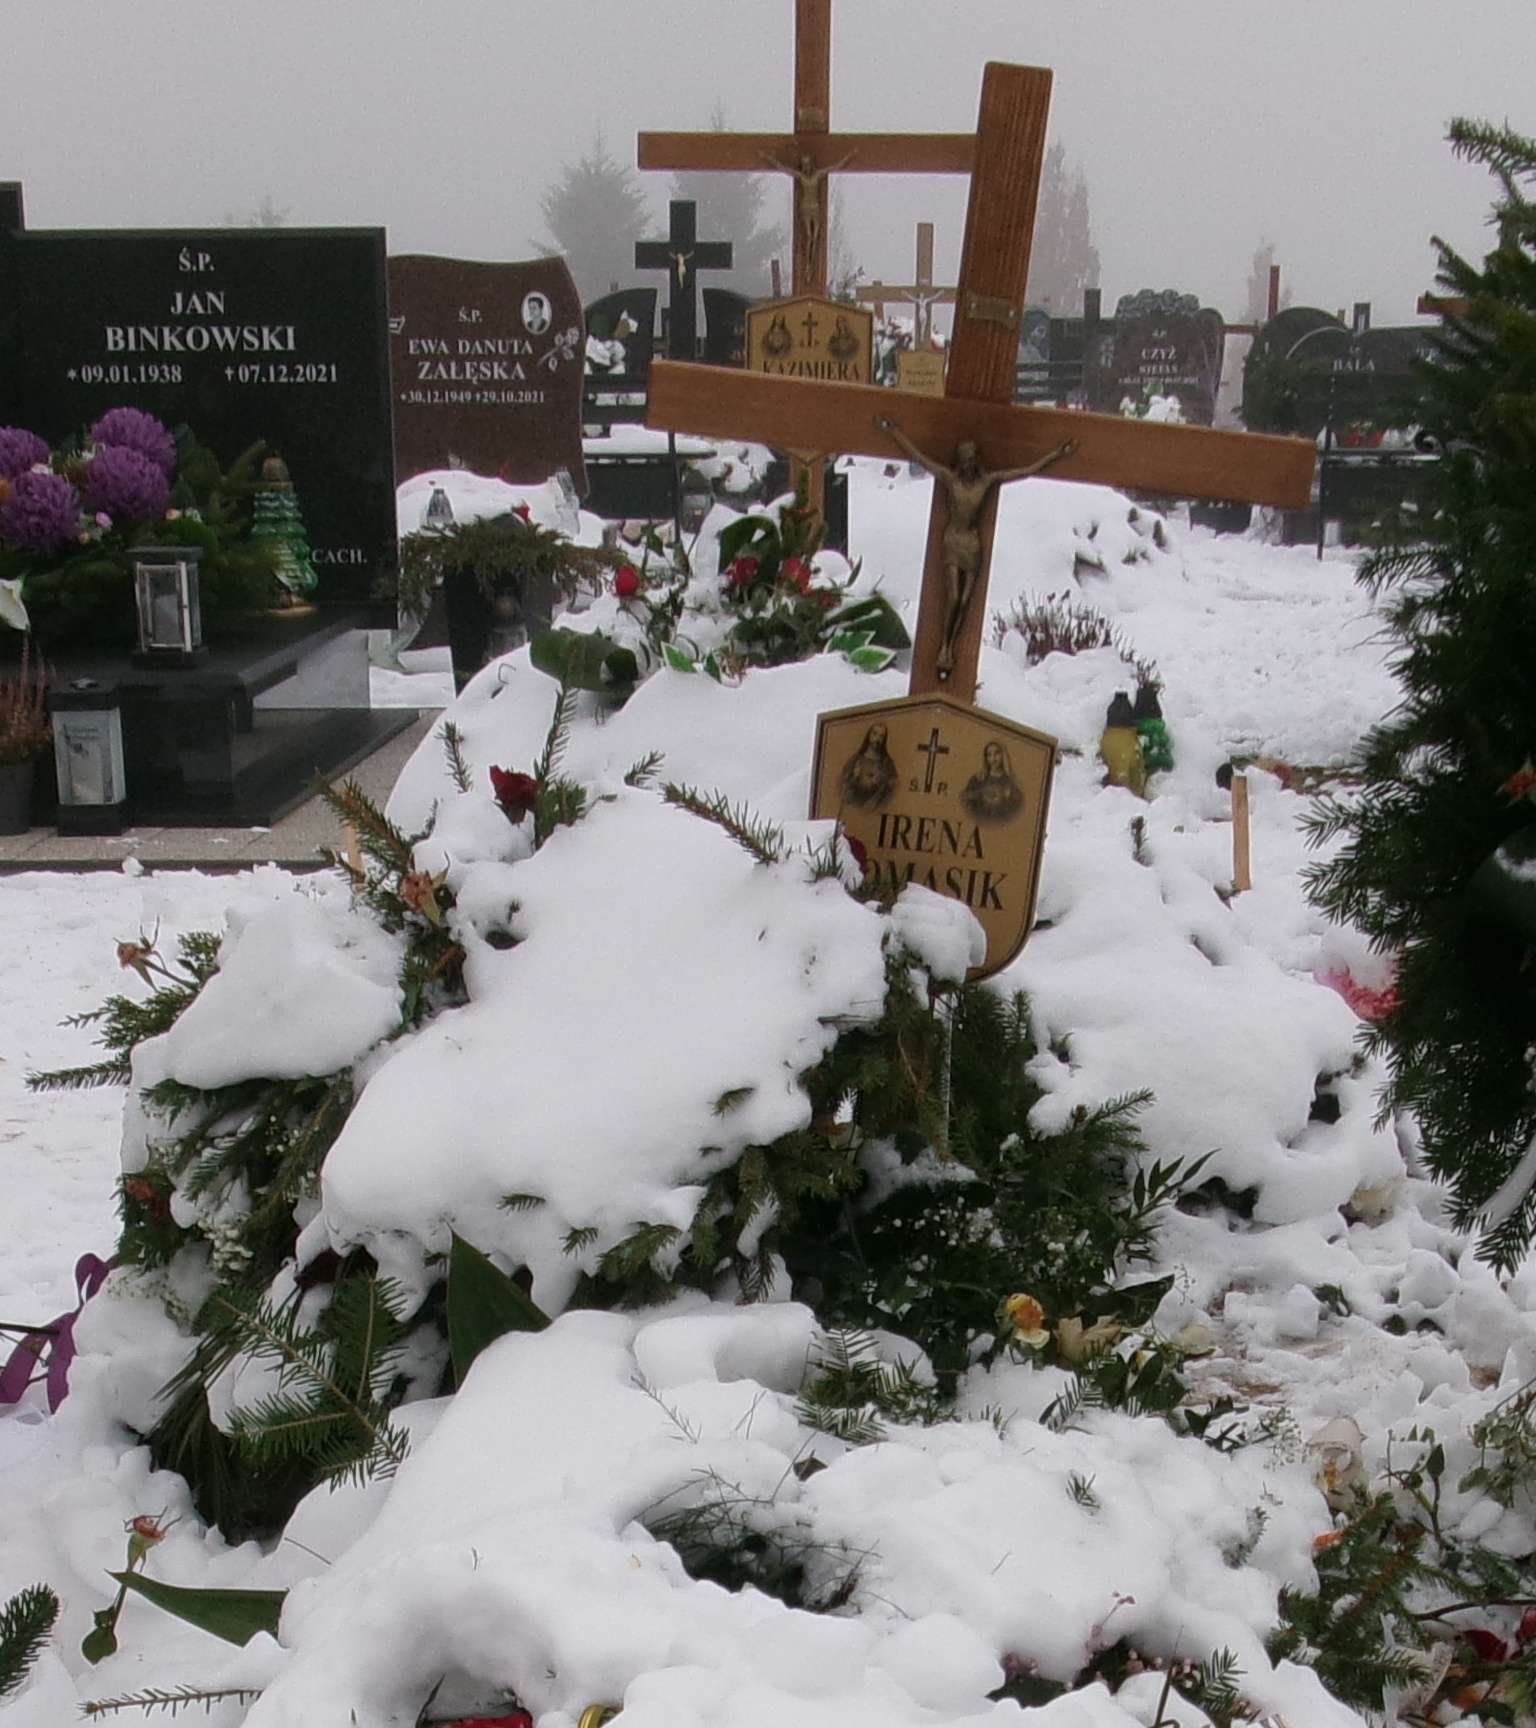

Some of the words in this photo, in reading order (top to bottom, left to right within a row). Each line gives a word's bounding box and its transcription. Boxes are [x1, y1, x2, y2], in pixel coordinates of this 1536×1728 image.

[170, 291, 226, 316] JAN
[106, 325, 297, 353] BINKOWSKI
[409, 339, 450, 356] EWA
[458, 339, 534, 355] DANUTA
[1141, 345, 1177, 360] CZYŻ
[418, 361, 526, 384] ZAŁĘSKA
[878, 814, 984, 859] IRENA
